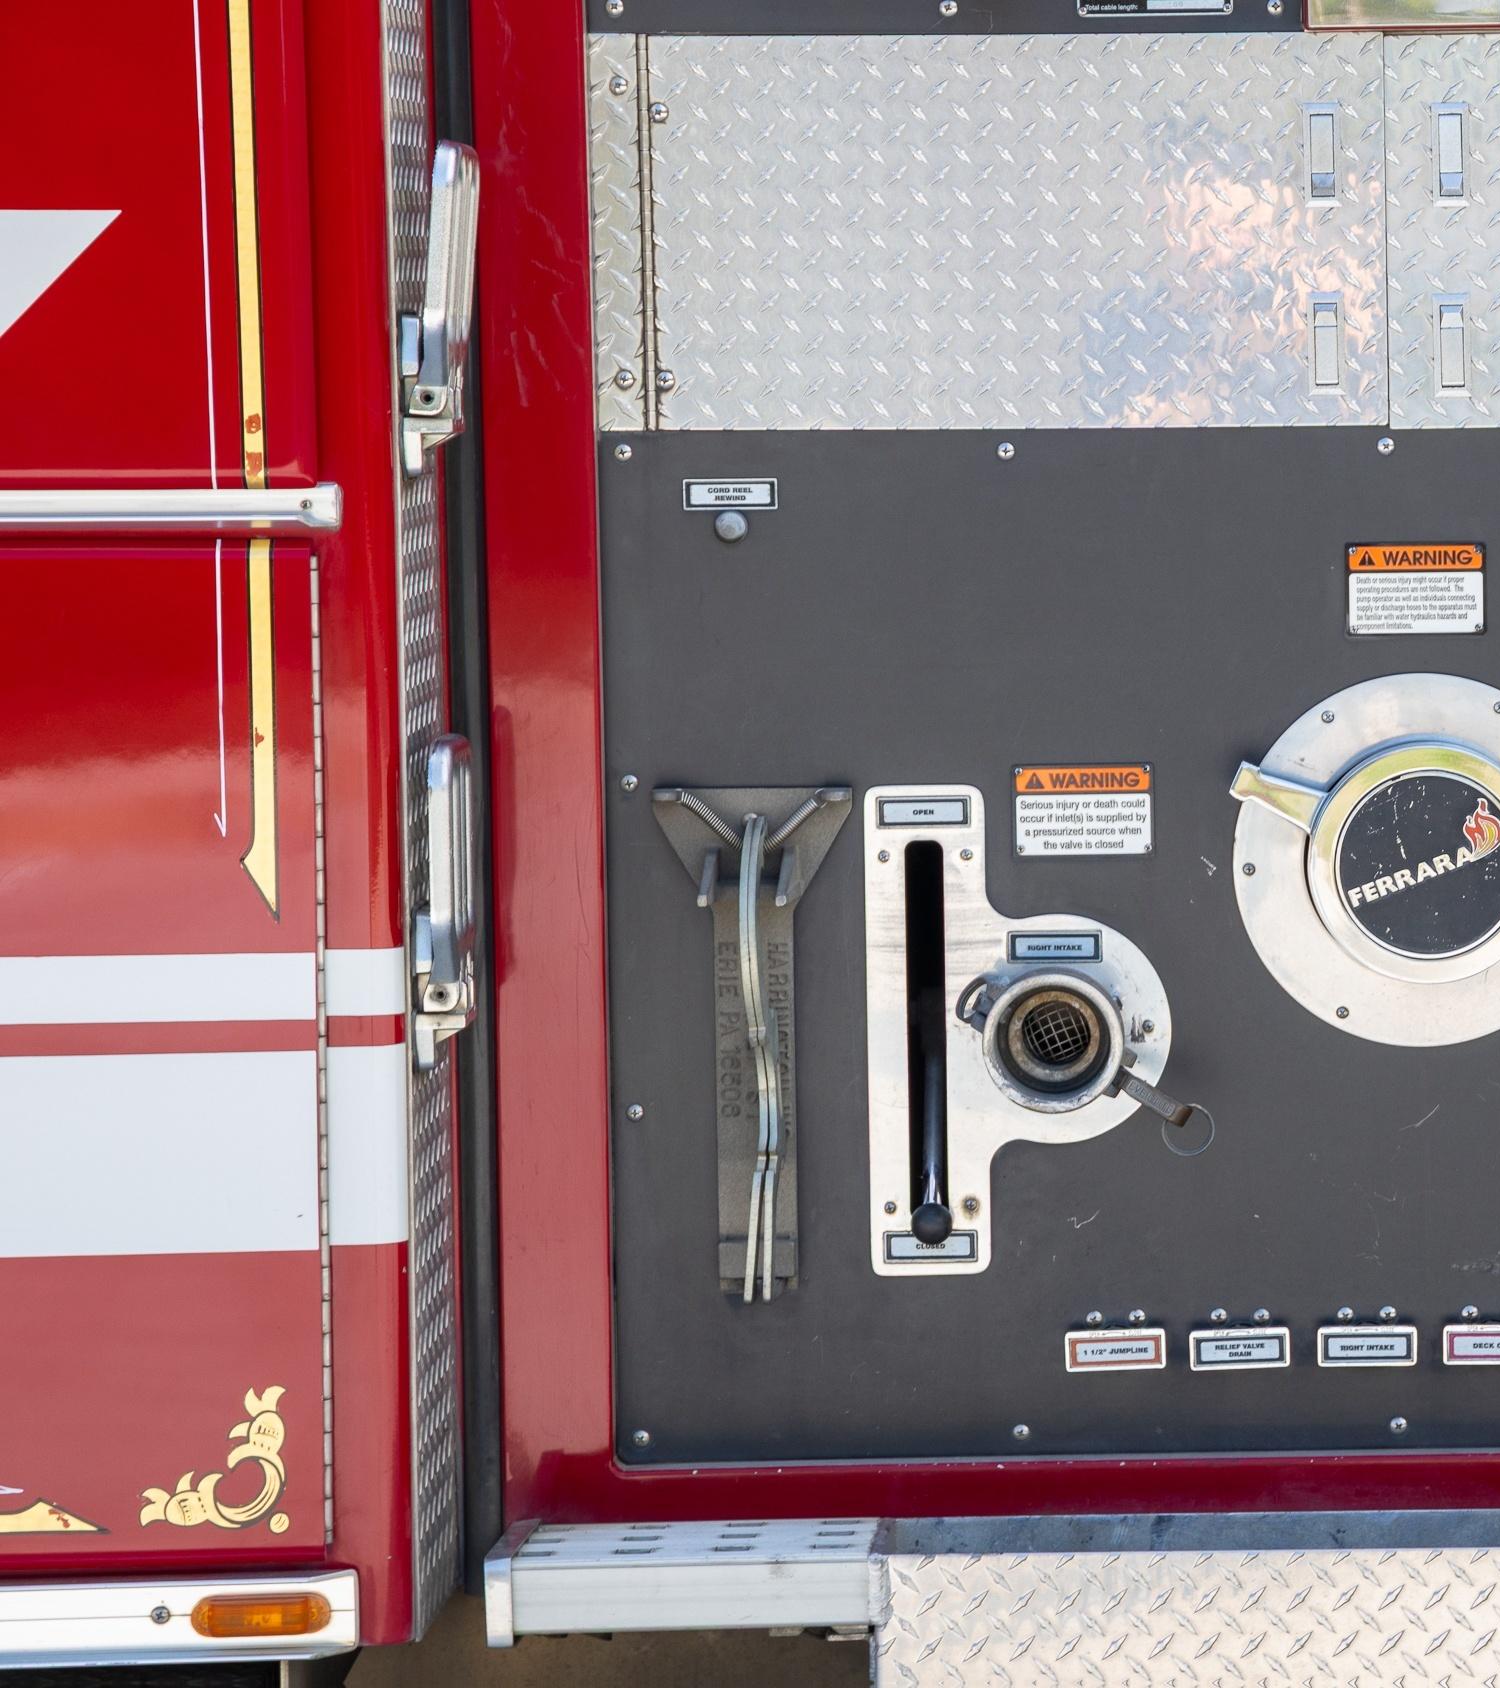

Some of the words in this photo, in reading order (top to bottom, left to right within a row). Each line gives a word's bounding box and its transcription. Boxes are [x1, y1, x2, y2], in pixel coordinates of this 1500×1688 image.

[1382, 550, 1472, 566] WARNING
[1050, 772, 1140, 788] WARNING
[1020, 801, 1053, 809] Serious
[1056, 800, 1080, 811] injury
[1094, 800, 1118, 808] death
[1121, 799, 1145, 807] could
[1047, 814, 1053, 822] if
[1055, 813, 1084, 824] inlet(s)
[1086, 814, 1093, 822] is
[1096, 813, 1134, 823] supplied
[1136, 813, 1147, 823] by
[1033, 827, 1084, 838] pressurized
[1119, 827, 1141, 835] when
[1044, 841, 1057, 849] the
[1060, 840, 1082, 849] valve
[1086, 840, 1092, 848] is
[1095, 840, 1124, 848] closed
[1348, 846, 1475, 908] FERRARA
[717, 941, 738, 998] ERIE
[720, 1011, 741, 1037] PA
[1109, 1347, 1149, 1355] JUMPLINE
[1215, 1343, 1241, 1351] RELIEF
